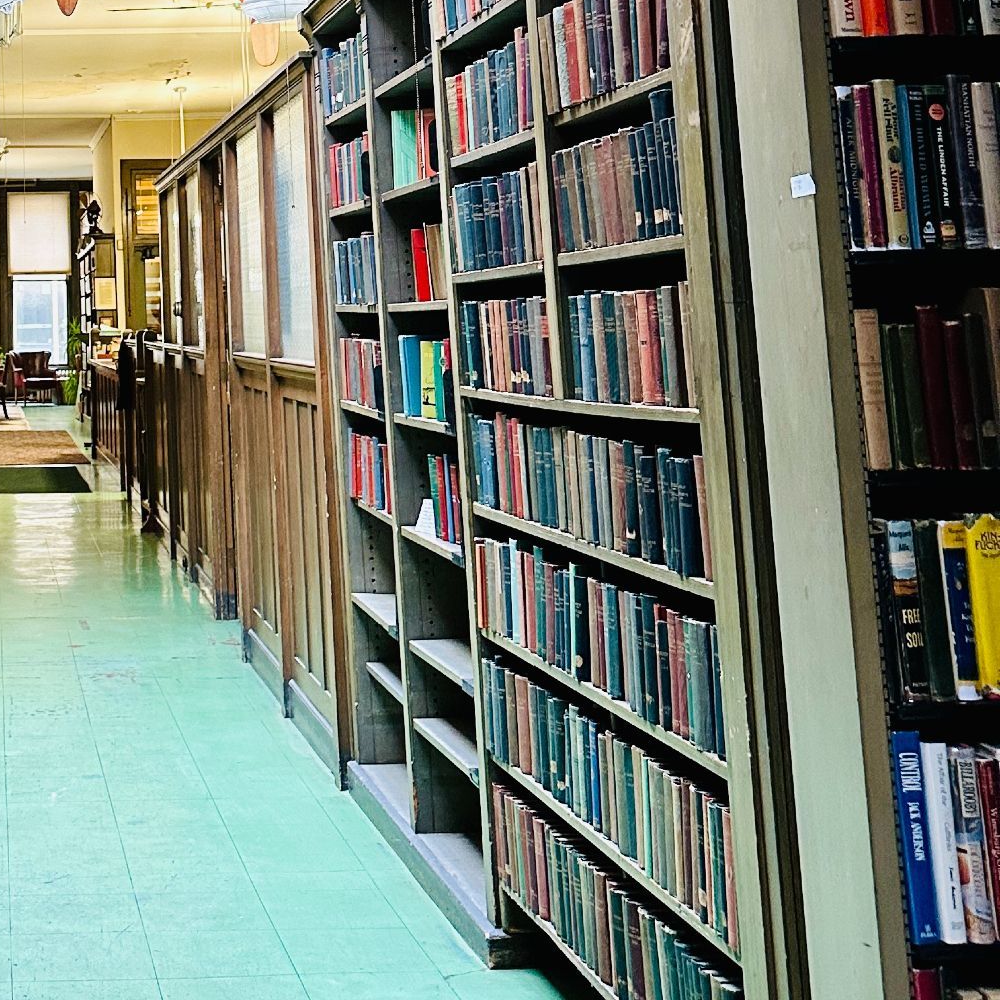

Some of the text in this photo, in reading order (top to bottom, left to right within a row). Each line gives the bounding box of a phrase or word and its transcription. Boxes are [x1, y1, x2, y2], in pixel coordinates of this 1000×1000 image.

[961, 83, 972, 136] MANHATTAN
[938, 144, 946, 175] LINDEN
[966, 137, 975, 167] NORTH
[849, 151, 860, 200] MIDNIGHT
[889, 166, 901, 213] Albrand
[941, 176, 950, 207] AFFAIR
[902, 608, 920, 625] FREE
[898, 752, 922, 793] CONTROL
[958, 761, 976, 815] BILLAROOBY
[907, 802, 925, 862] JACK ANDERSON
